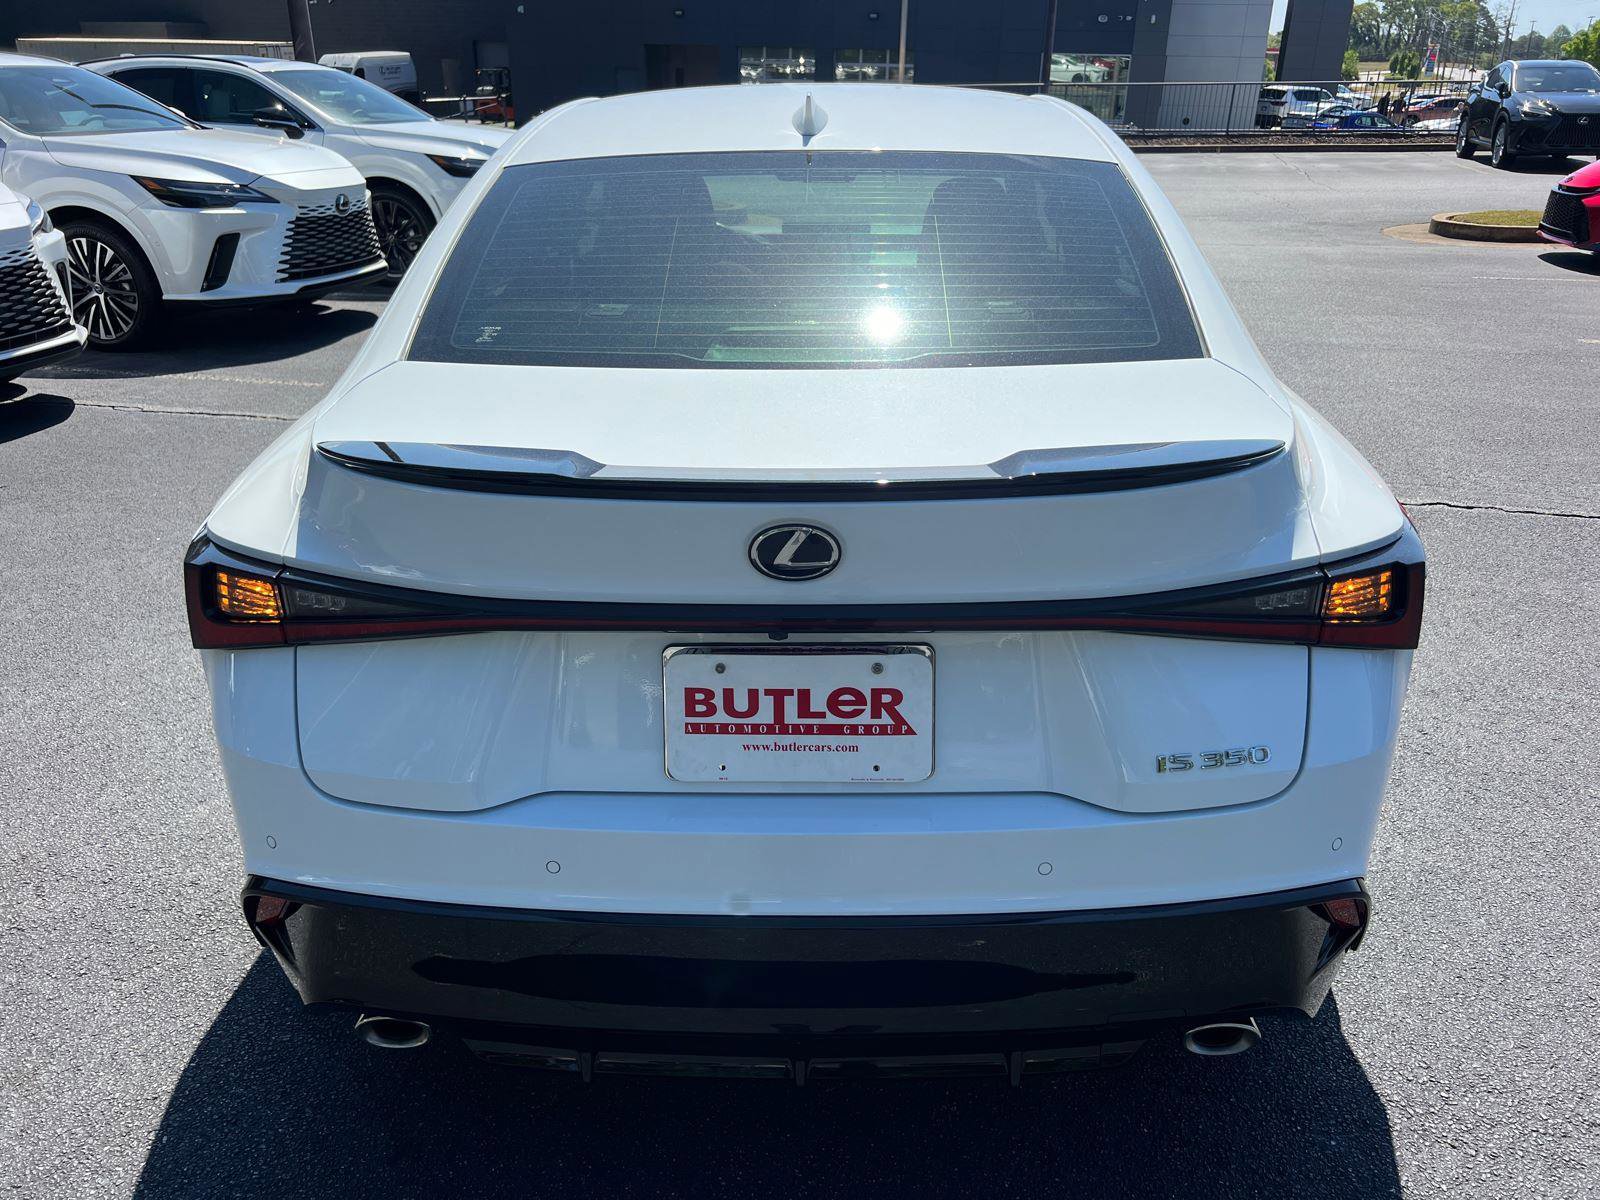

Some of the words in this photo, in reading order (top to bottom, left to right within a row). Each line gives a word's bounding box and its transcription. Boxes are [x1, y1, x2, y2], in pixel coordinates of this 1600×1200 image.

[685, 724, 820, 734] AUTOMOTIVE
[843, 724, 907, 735] GROUP
[742, 742, 860, 753] www.butlercars.com
[1156, 753, 1194, 773] IS
[1200, 746, 1271, 770] 350
